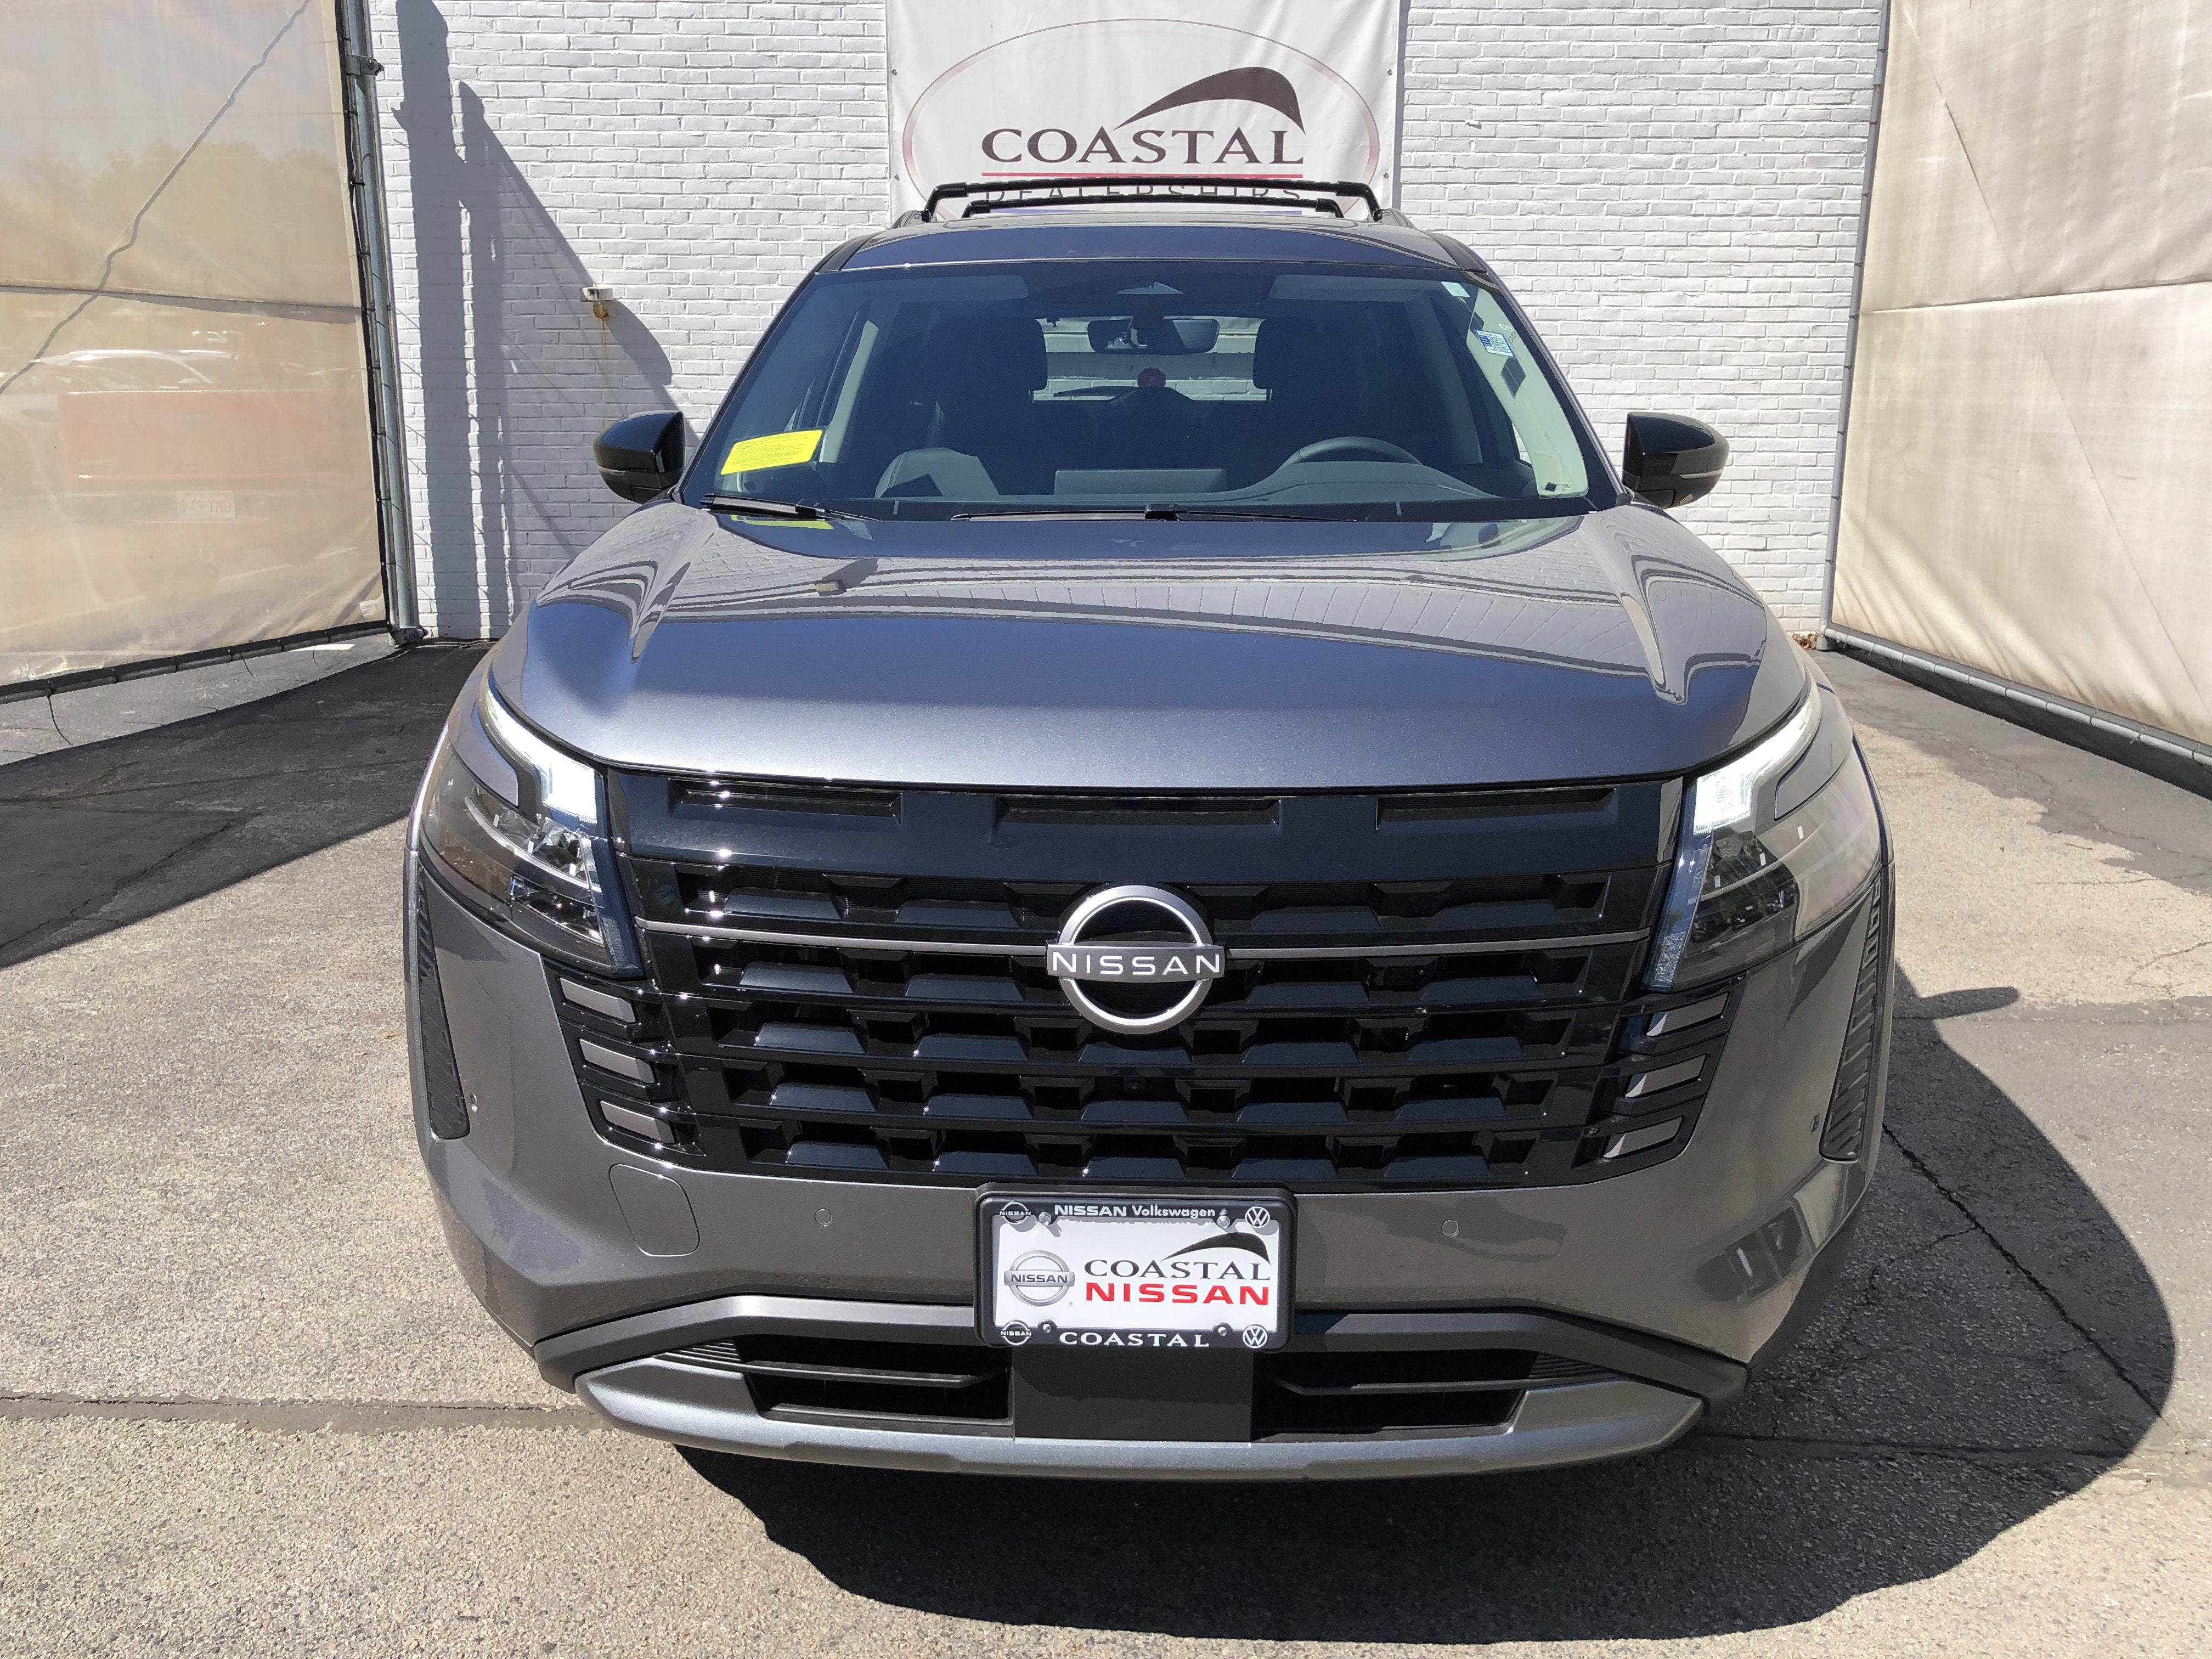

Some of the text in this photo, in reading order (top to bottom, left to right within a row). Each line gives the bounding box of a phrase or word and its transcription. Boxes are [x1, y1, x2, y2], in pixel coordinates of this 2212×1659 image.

[981, 126, 1304, 165] COASTAL
[1053, 951, 1220, 975] NISSAN
[1054, 1204, 1216, 1218] NISSAN Volkswagen
[1011, 1274, 1068, 1283] NISSAN
[1084, 1260, 1271, 1281] COASTAL
[1086, 1282, 1268, 1305] NISSAN
[1059, 1332, 1209, 1347] COASTAL
